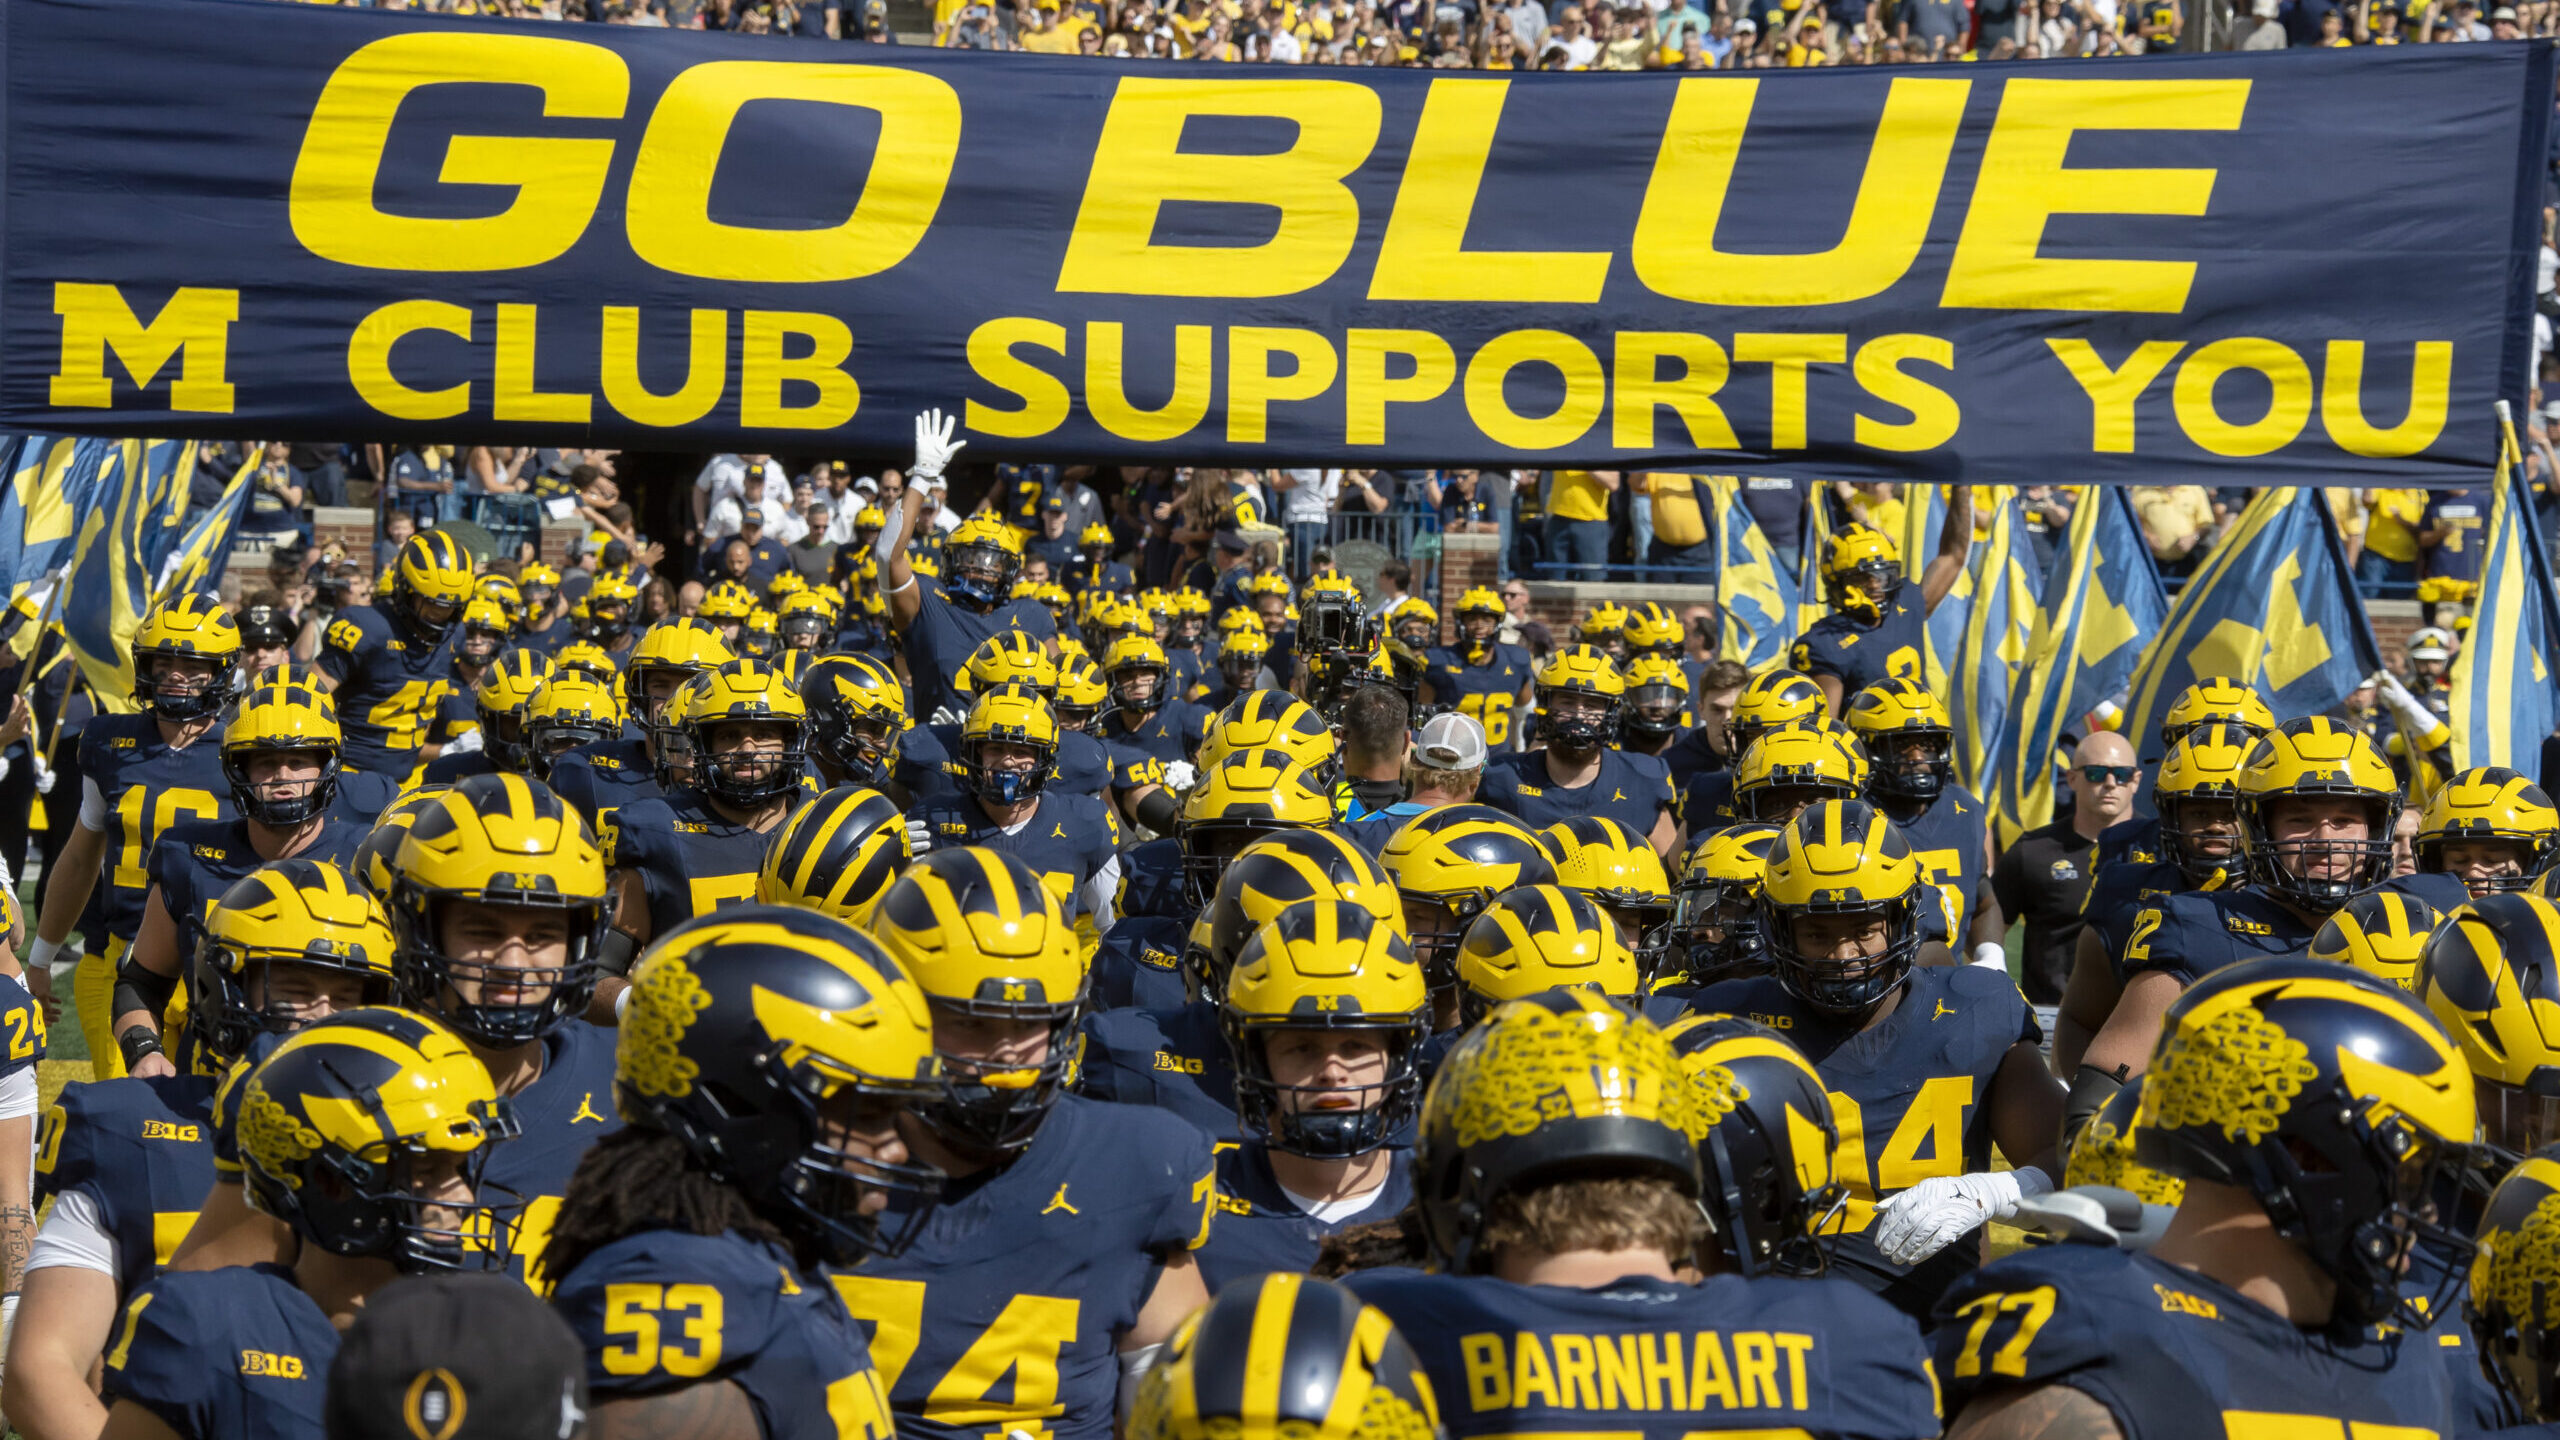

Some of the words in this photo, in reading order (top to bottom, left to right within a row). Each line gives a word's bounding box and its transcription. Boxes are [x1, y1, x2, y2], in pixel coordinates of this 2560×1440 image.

[288, 32, 963, 284] GO
[1055, 76, 2253, 315] BLUE
[49, 281, 240, 414] M
[346, 300, 861, 431] CLUB
[964, 316, 1961, 453] SUPPORTS
[2045, 337, 2453, 458] YOU
[328, 619, 363, 652] 49
[570, 709, 580, 717] M
[744, 701, 757, 710] M
[1003, 725, 1013, 733] M
[1787, 766, 1799, 774] M
[2317, 770, 2333, 780] M
[2459, 818, 2473, 828] M
[514, 873, 536, 889] M
[1829, 890, 1845, 902] M
[332, 941, 350, 956] M
[1003, 984, 1026, 1001] M
[1316, 996, 1338, 1010] M
[4, 998, 47, 1061] 24
[601, 1283, 724, 1378] 53
[1953, 1285, 2057, 1378] 77
[829, 1274, 1081, 1440] 74
[1460, 1330, 1814, 1413] BARNHART
